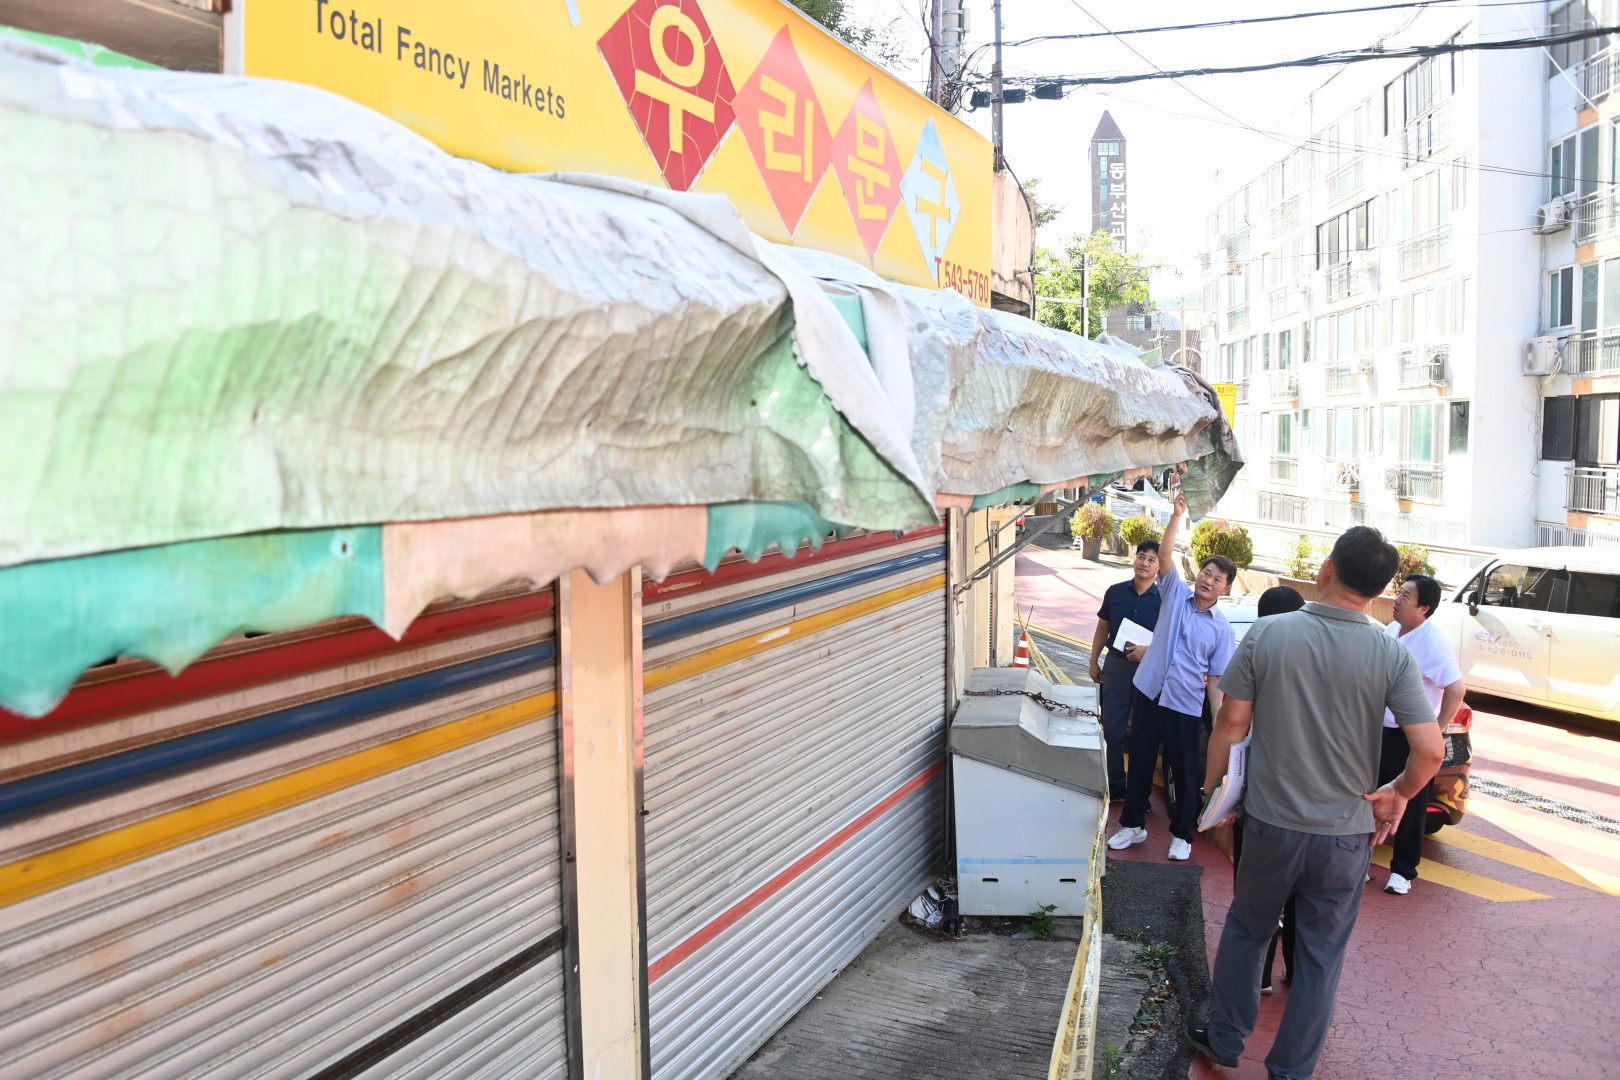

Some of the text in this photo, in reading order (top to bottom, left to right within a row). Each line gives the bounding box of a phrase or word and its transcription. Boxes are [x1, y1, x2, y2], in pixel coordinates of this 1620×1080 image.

[315, 0, 567, 120] Total Fancy Markets
